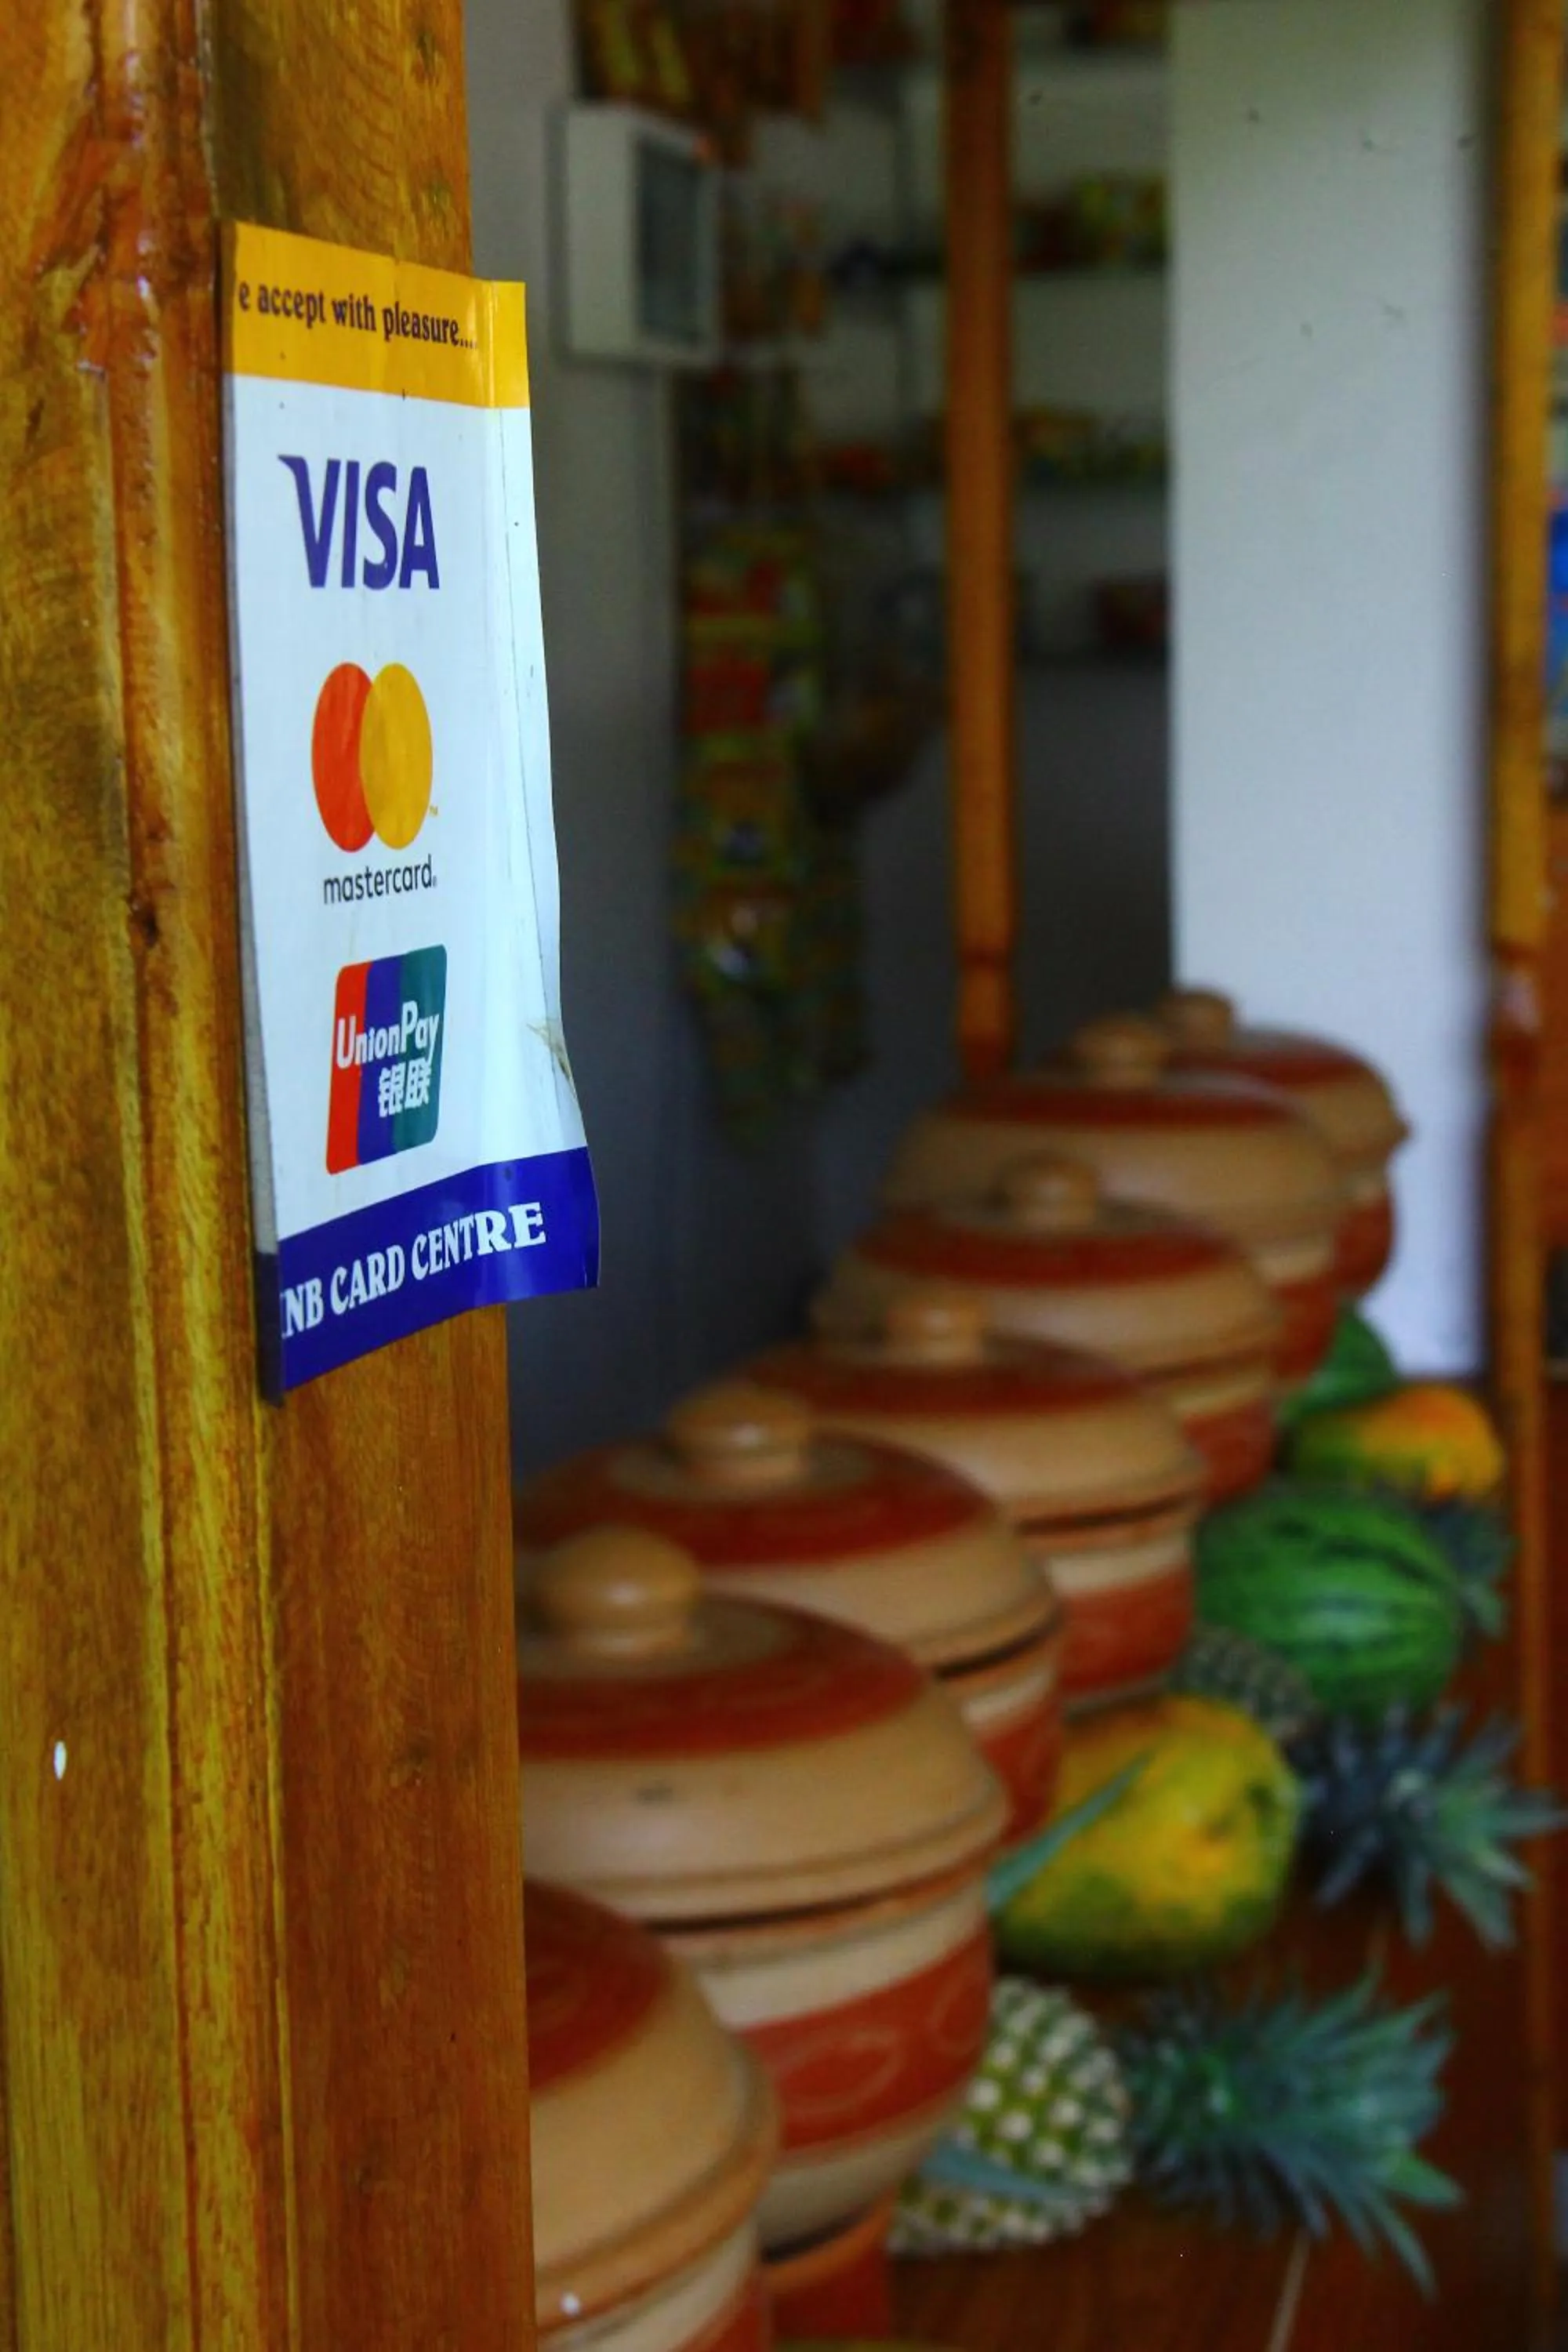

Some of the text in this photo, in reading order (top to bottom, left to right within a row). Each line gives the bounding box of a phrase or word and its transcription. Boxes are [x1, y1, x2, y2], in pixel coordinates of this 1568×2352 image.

[257, 283, 325, 329] accept
[332, 293, 376, 332] with
[278, 454, 440, 590] VISA
[336, 1000, 439, 1069] UnionPay
[279, 1203, 546, 1340] NB CARD CENTRE
